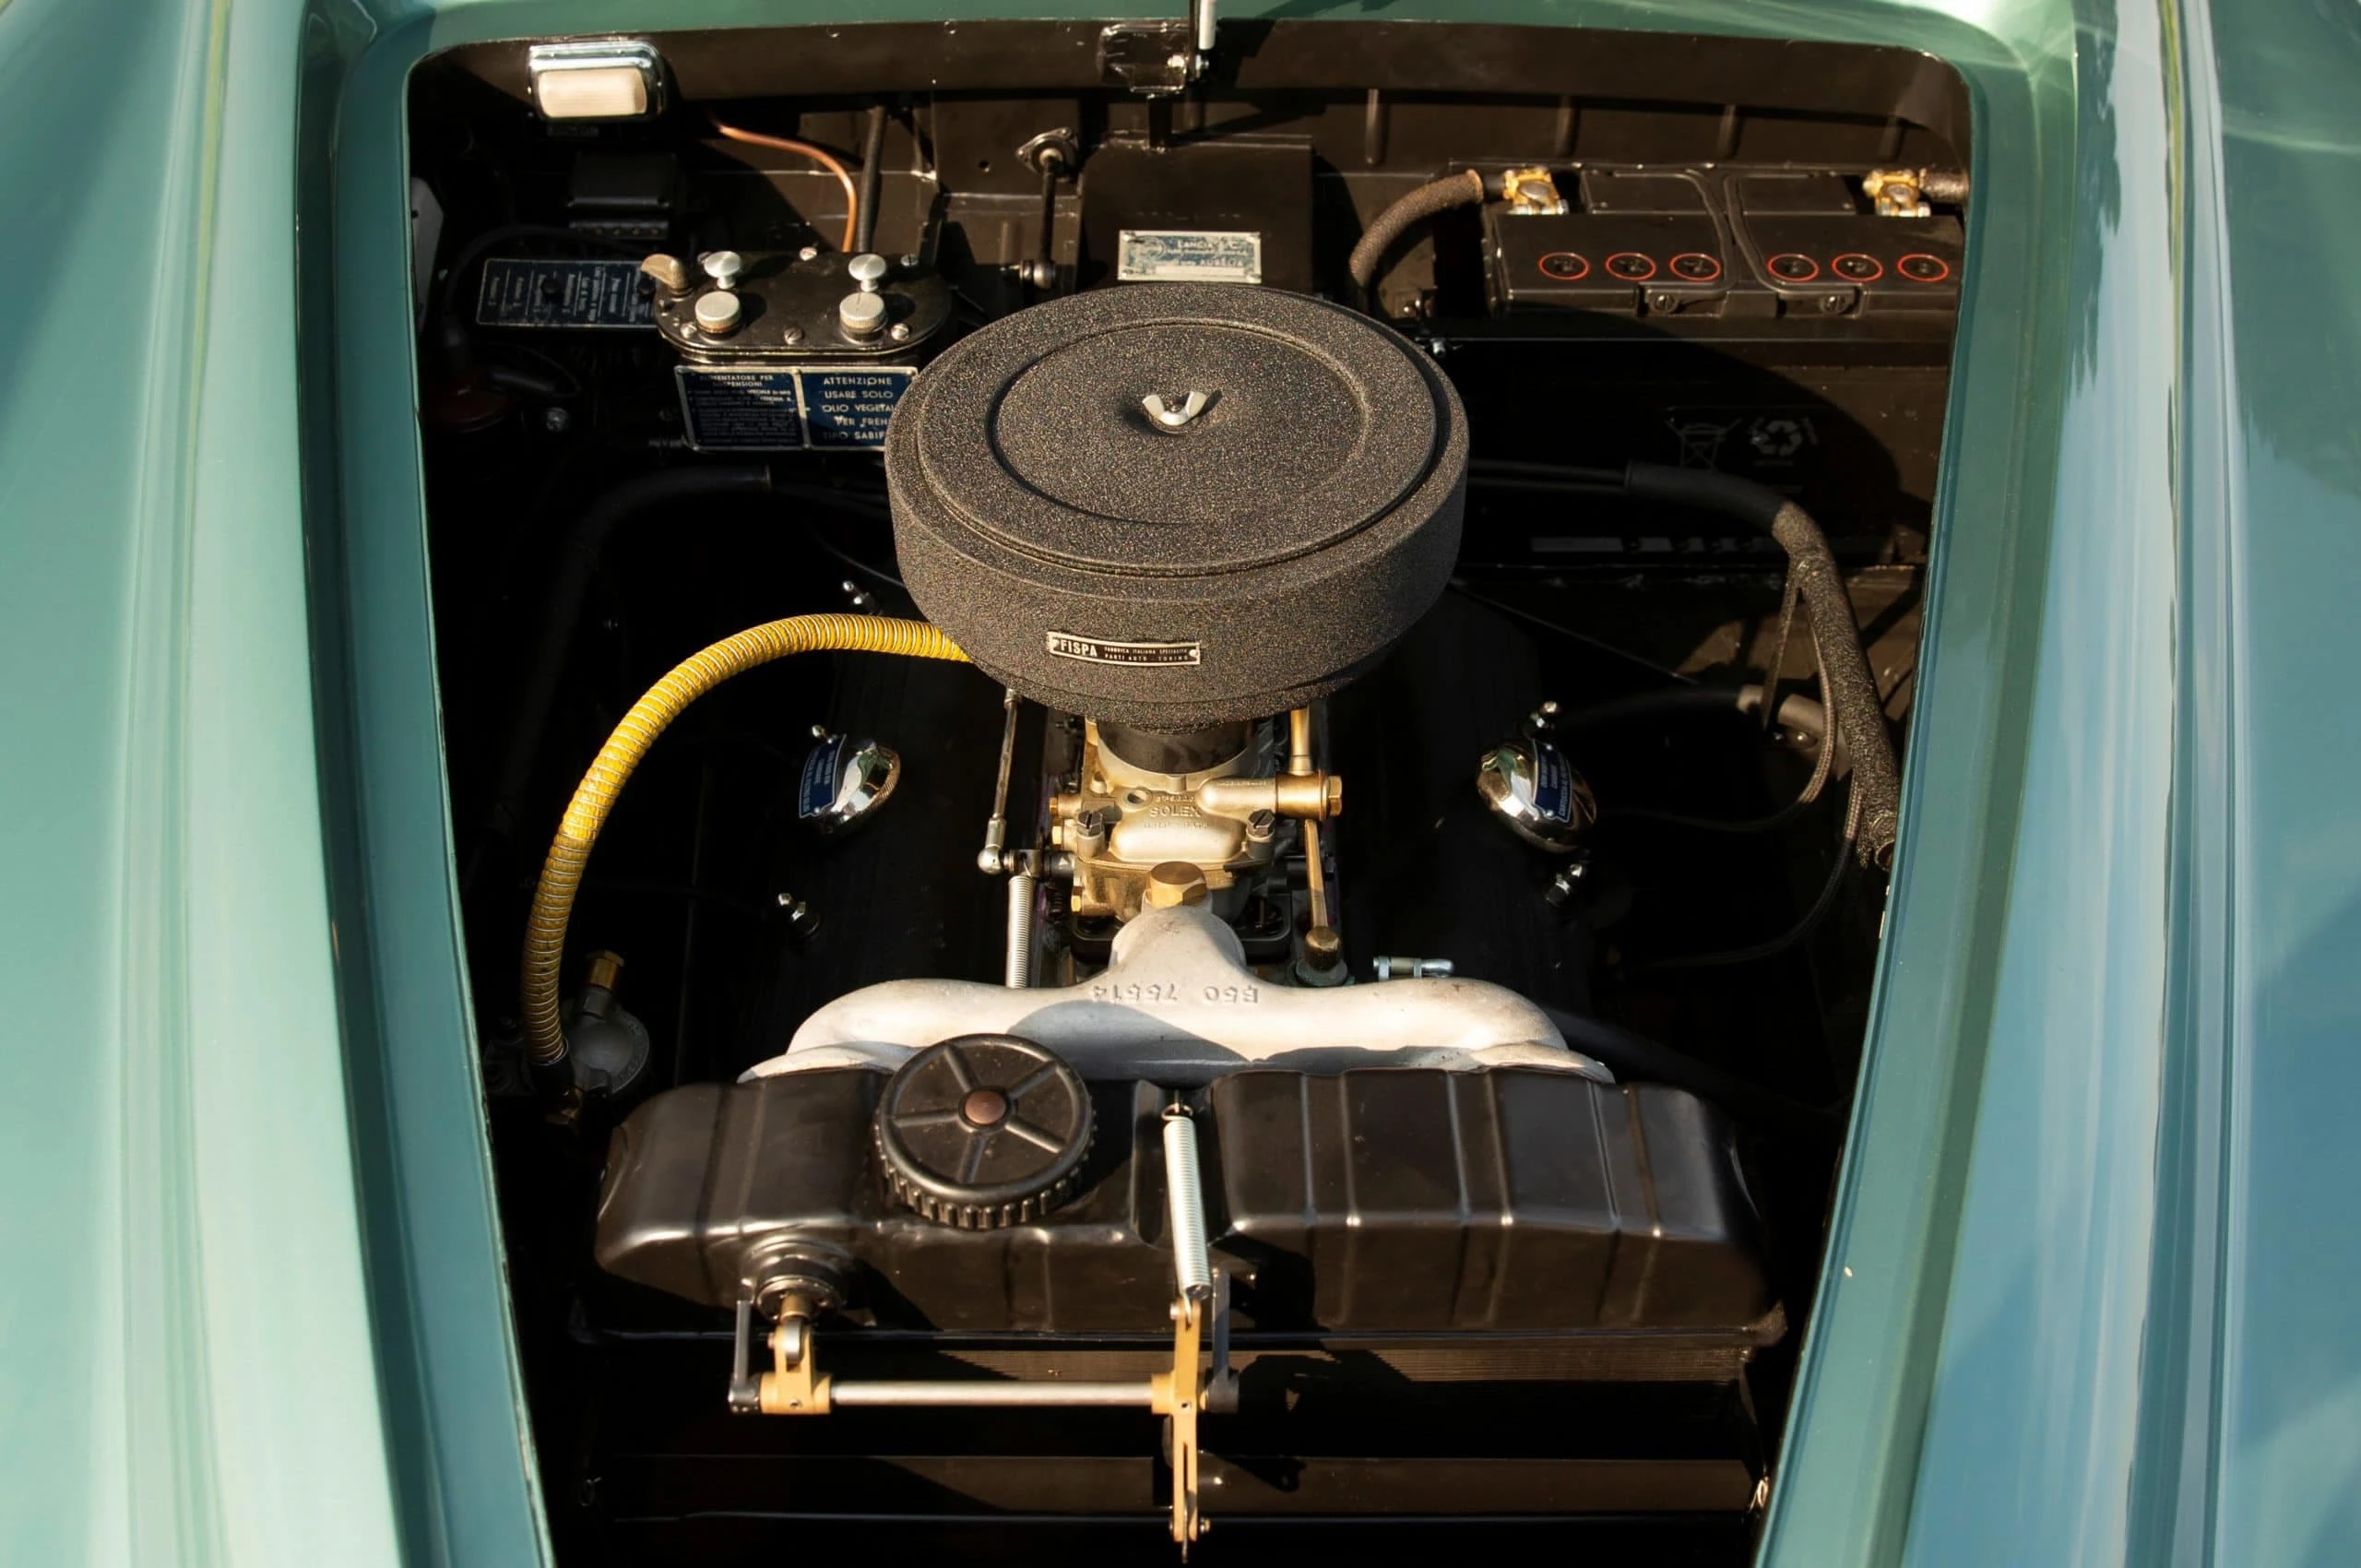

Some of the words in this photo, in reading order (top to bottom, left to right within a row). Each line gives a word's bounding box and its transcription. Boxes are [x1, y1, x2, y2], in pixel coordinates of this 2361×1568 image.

[823, 376, 893, 386] ATTENZIONE
[824, 390, 857, 398] USARE
[861, 390, 894, 398] SOLO
[822, 404, 849, 412] OLIO
[834, 416, 856, 426] PER
[861, 417, 889, 426] FREN
[1060, 639, 1097, 658] FISPA
[1150, 805, 1203, 818] SOLEX
[1092, 983, 1178, 1002] 75514
